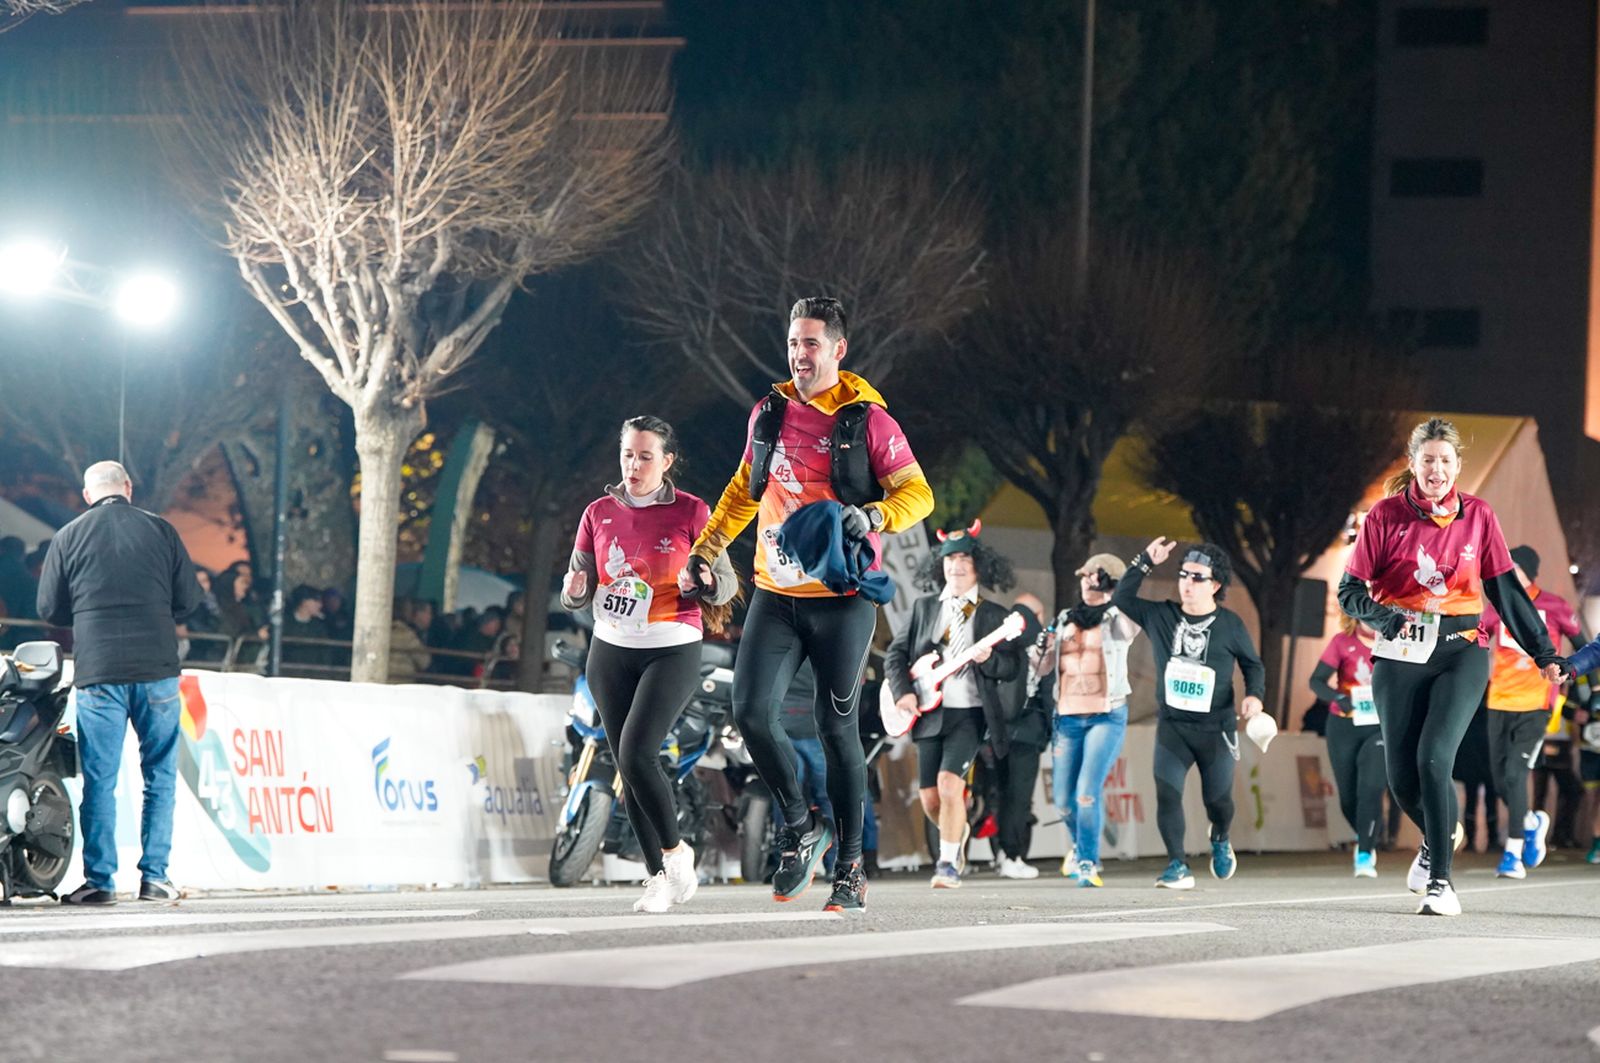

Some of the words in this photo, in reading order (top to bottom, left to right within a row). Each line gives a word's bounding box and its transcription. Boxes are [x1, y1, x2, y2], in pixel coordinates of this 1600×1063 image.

[775, 464, 791, 483] 43
[603, 594, 638, 617] 5757
[1173, 679, 1205, 696] 8085
[233, 728, 285, 777] SAN
[198, 749, 237, 830] 43
[248, 771, 334, 834] ANTÓN
